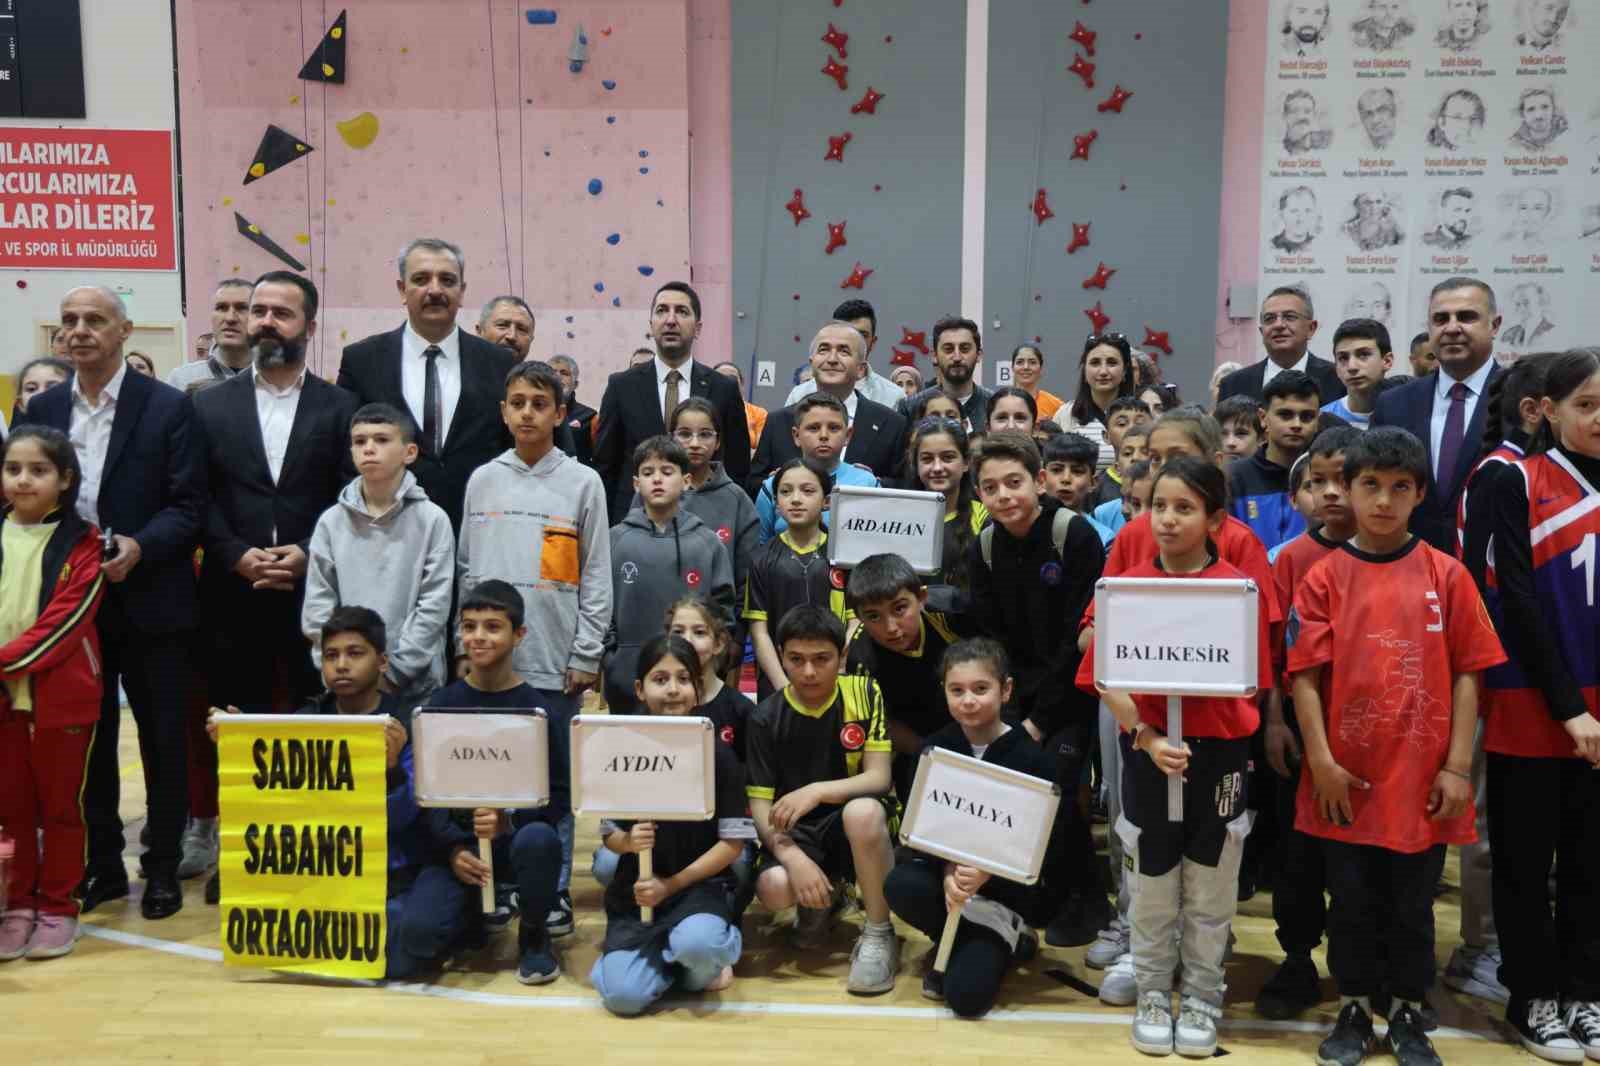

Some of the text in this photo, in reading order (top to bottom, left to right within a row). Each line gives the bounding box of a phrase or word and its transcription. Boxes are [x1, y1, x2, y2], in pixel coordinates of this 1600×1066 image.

[55, 199, 155, 231] DİLERİZ
[5, 239, 158, 258] VE SPOR İL MÜDÜRLÜĞÜ
[759, 368, 772, 383] A
[1000, 367, 1011, 381] B
[842, 517, 926, 538] ARDAHAN
[1115, 643, 1231, 664] BALIKESİR
[252, 737, 355, 791] SADIKA
[449, 747, 512, 762] ADANA
[604, 754, 677, 773] AYDIN
[926, 788, 1014, 830] ANTALYA
[243, 823, 364, 878] SABANCI
[226, 907, 381, 963] ORTAOKULU
